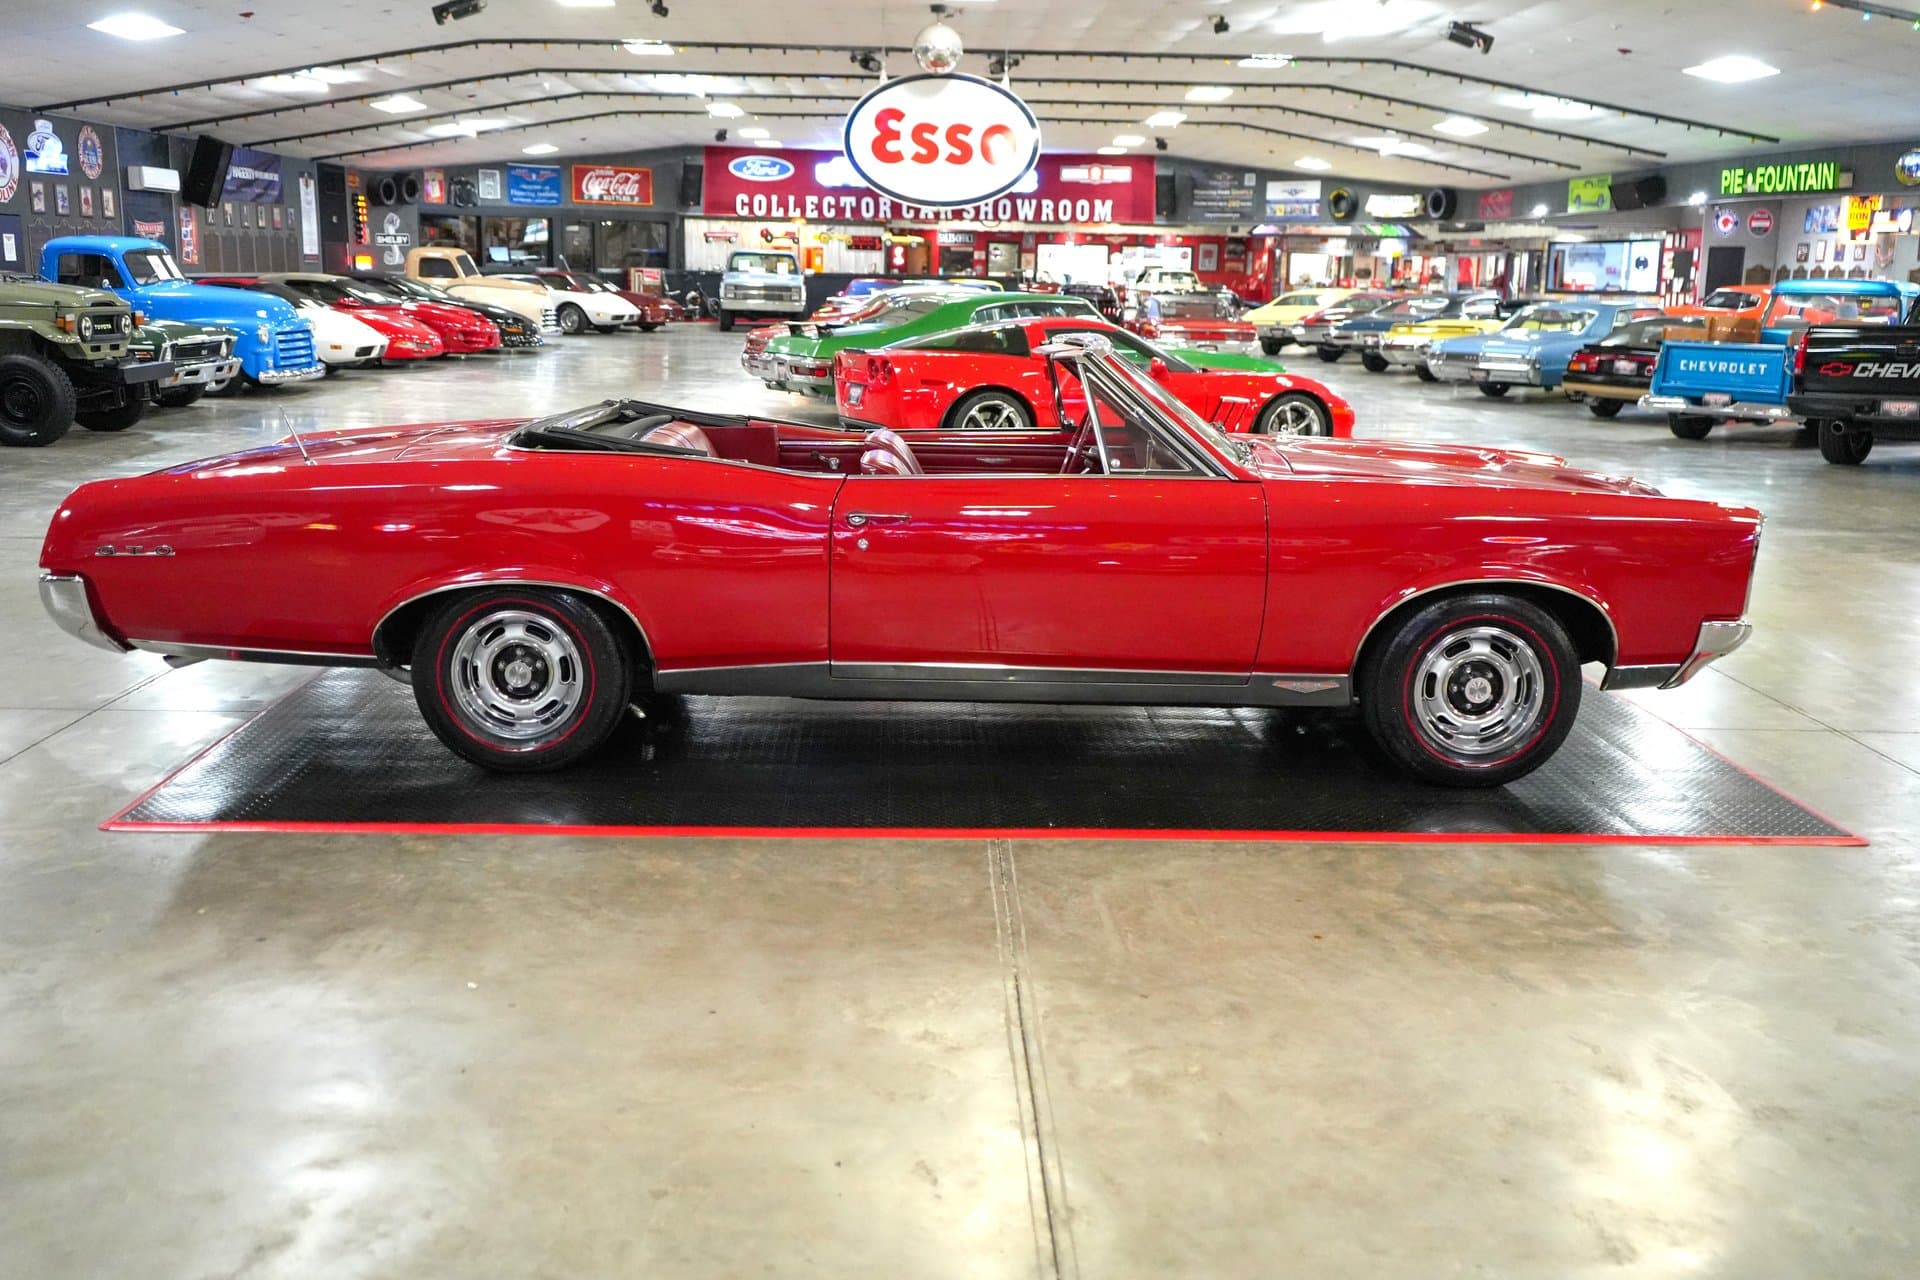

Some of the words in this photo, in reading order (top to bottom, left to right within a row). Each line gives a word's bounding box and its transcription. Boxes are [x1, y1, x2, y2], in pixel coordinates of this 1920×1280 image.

[742, 159, 780, 177] Ford
[582, 171, 640, 198] Coca-Cola
[1721, 168, 1744, 194] PIE
[1755, 162, 1835, 191] FOUNTAIN
[736, 193, 892, 219] COLLECTOR
[962, 198, 1113, 222] SHOWROOM
[376, 235, 409, 244] SHELBY
[94, 323, 112, 331] TOYOTA
[1680, 359, 1768, 376] CHEVROLET
